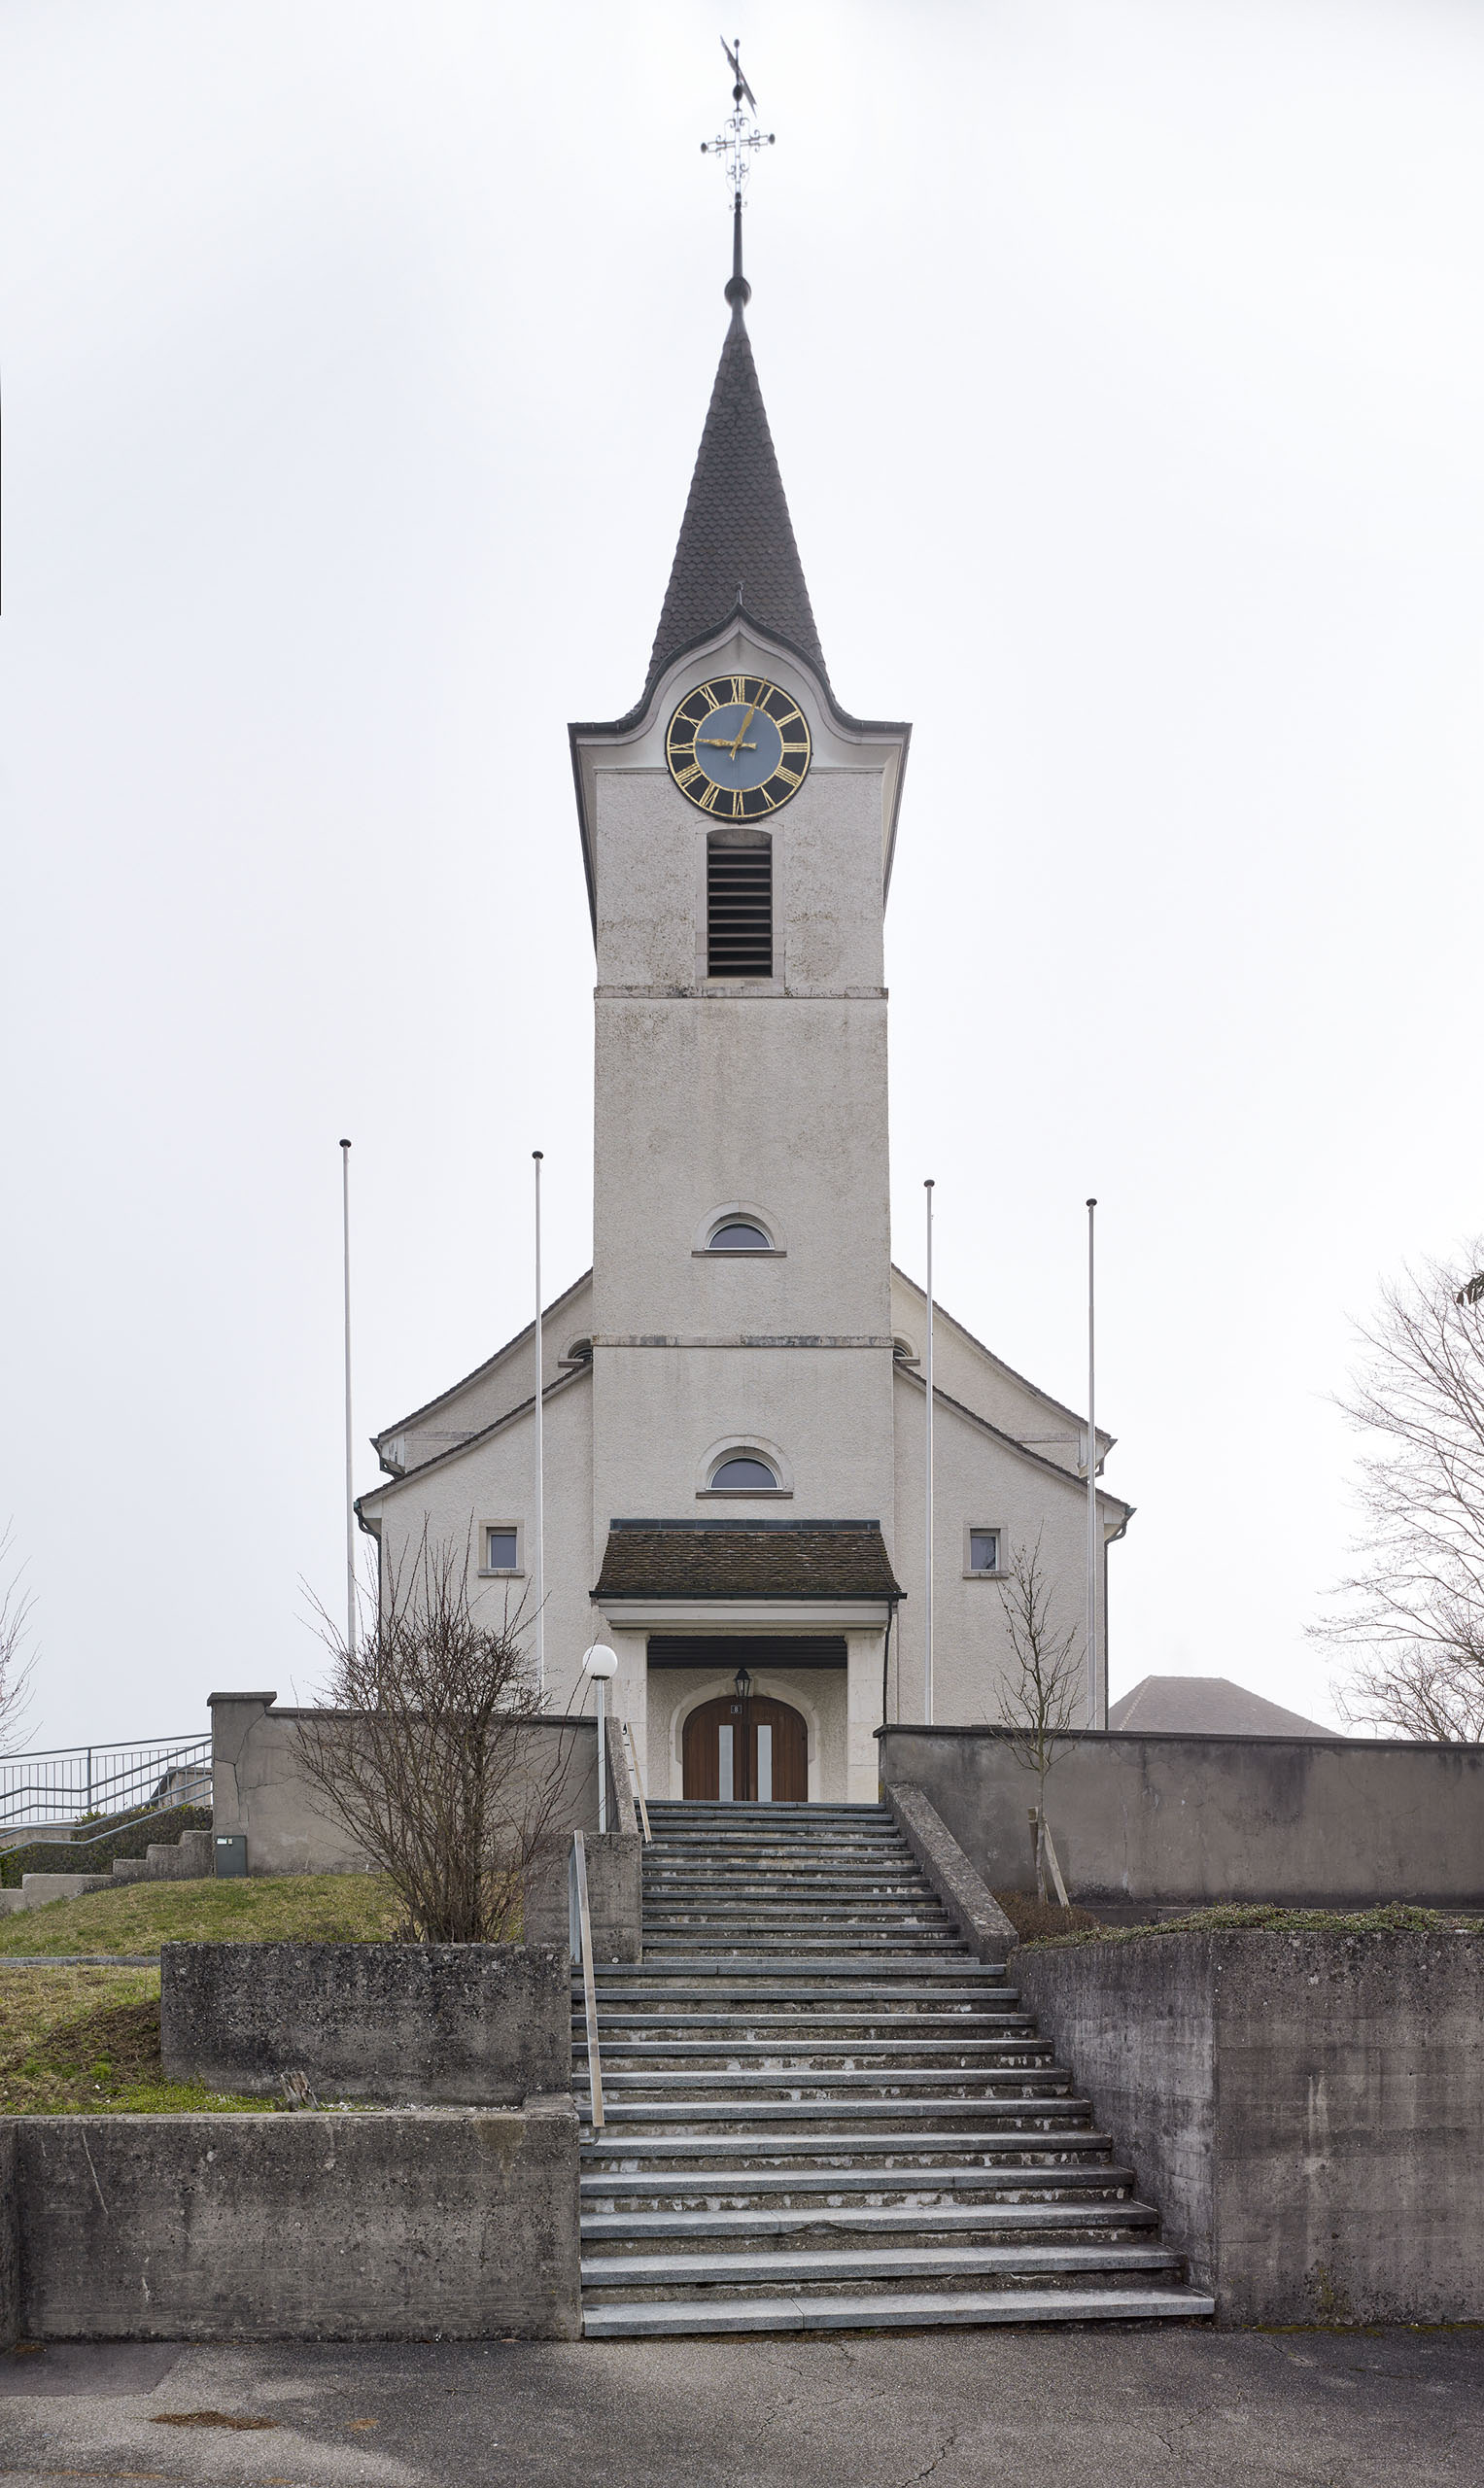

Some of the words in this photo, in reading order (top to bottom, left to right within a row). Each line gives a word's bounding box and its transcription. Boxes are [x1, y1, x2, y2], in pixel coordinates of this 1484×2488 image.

[700, 685, 719, 709] XI
[731, 677, 745, 703] XII
[675, 710, 702, 728] X
[777, 710, 802, 728] II
[669, 743, 695, 753] IX
[783, 743, 808, 752] III
[675, 762, 703, 788] VIII
[775, 766, 803, 786] IIII
[700, 783, 719, 810] VII
[733, 792, 744, 816] VI
[761, 786, 777, 808] V
